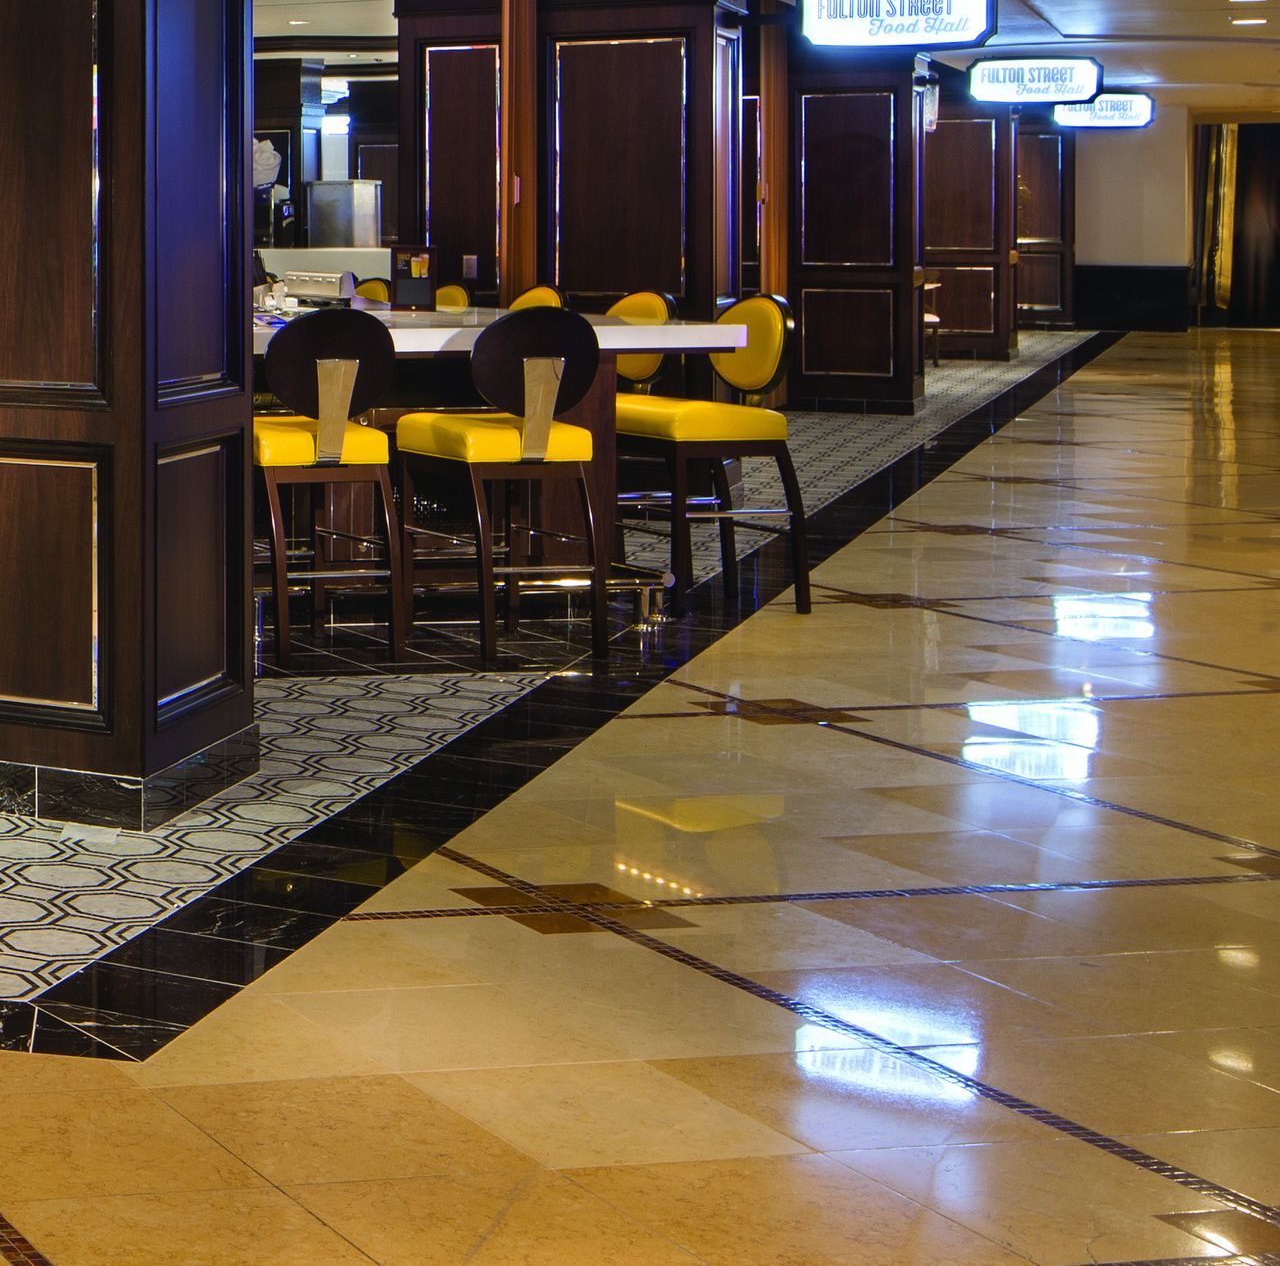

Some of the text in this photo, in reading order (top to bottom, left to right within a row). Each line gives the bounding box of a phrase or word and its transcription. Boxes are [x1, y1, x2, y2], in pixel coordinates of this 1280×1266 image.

[868, 16, 970, 36] Food Hall
[1016, 83, 1085, 95] Food Hall
